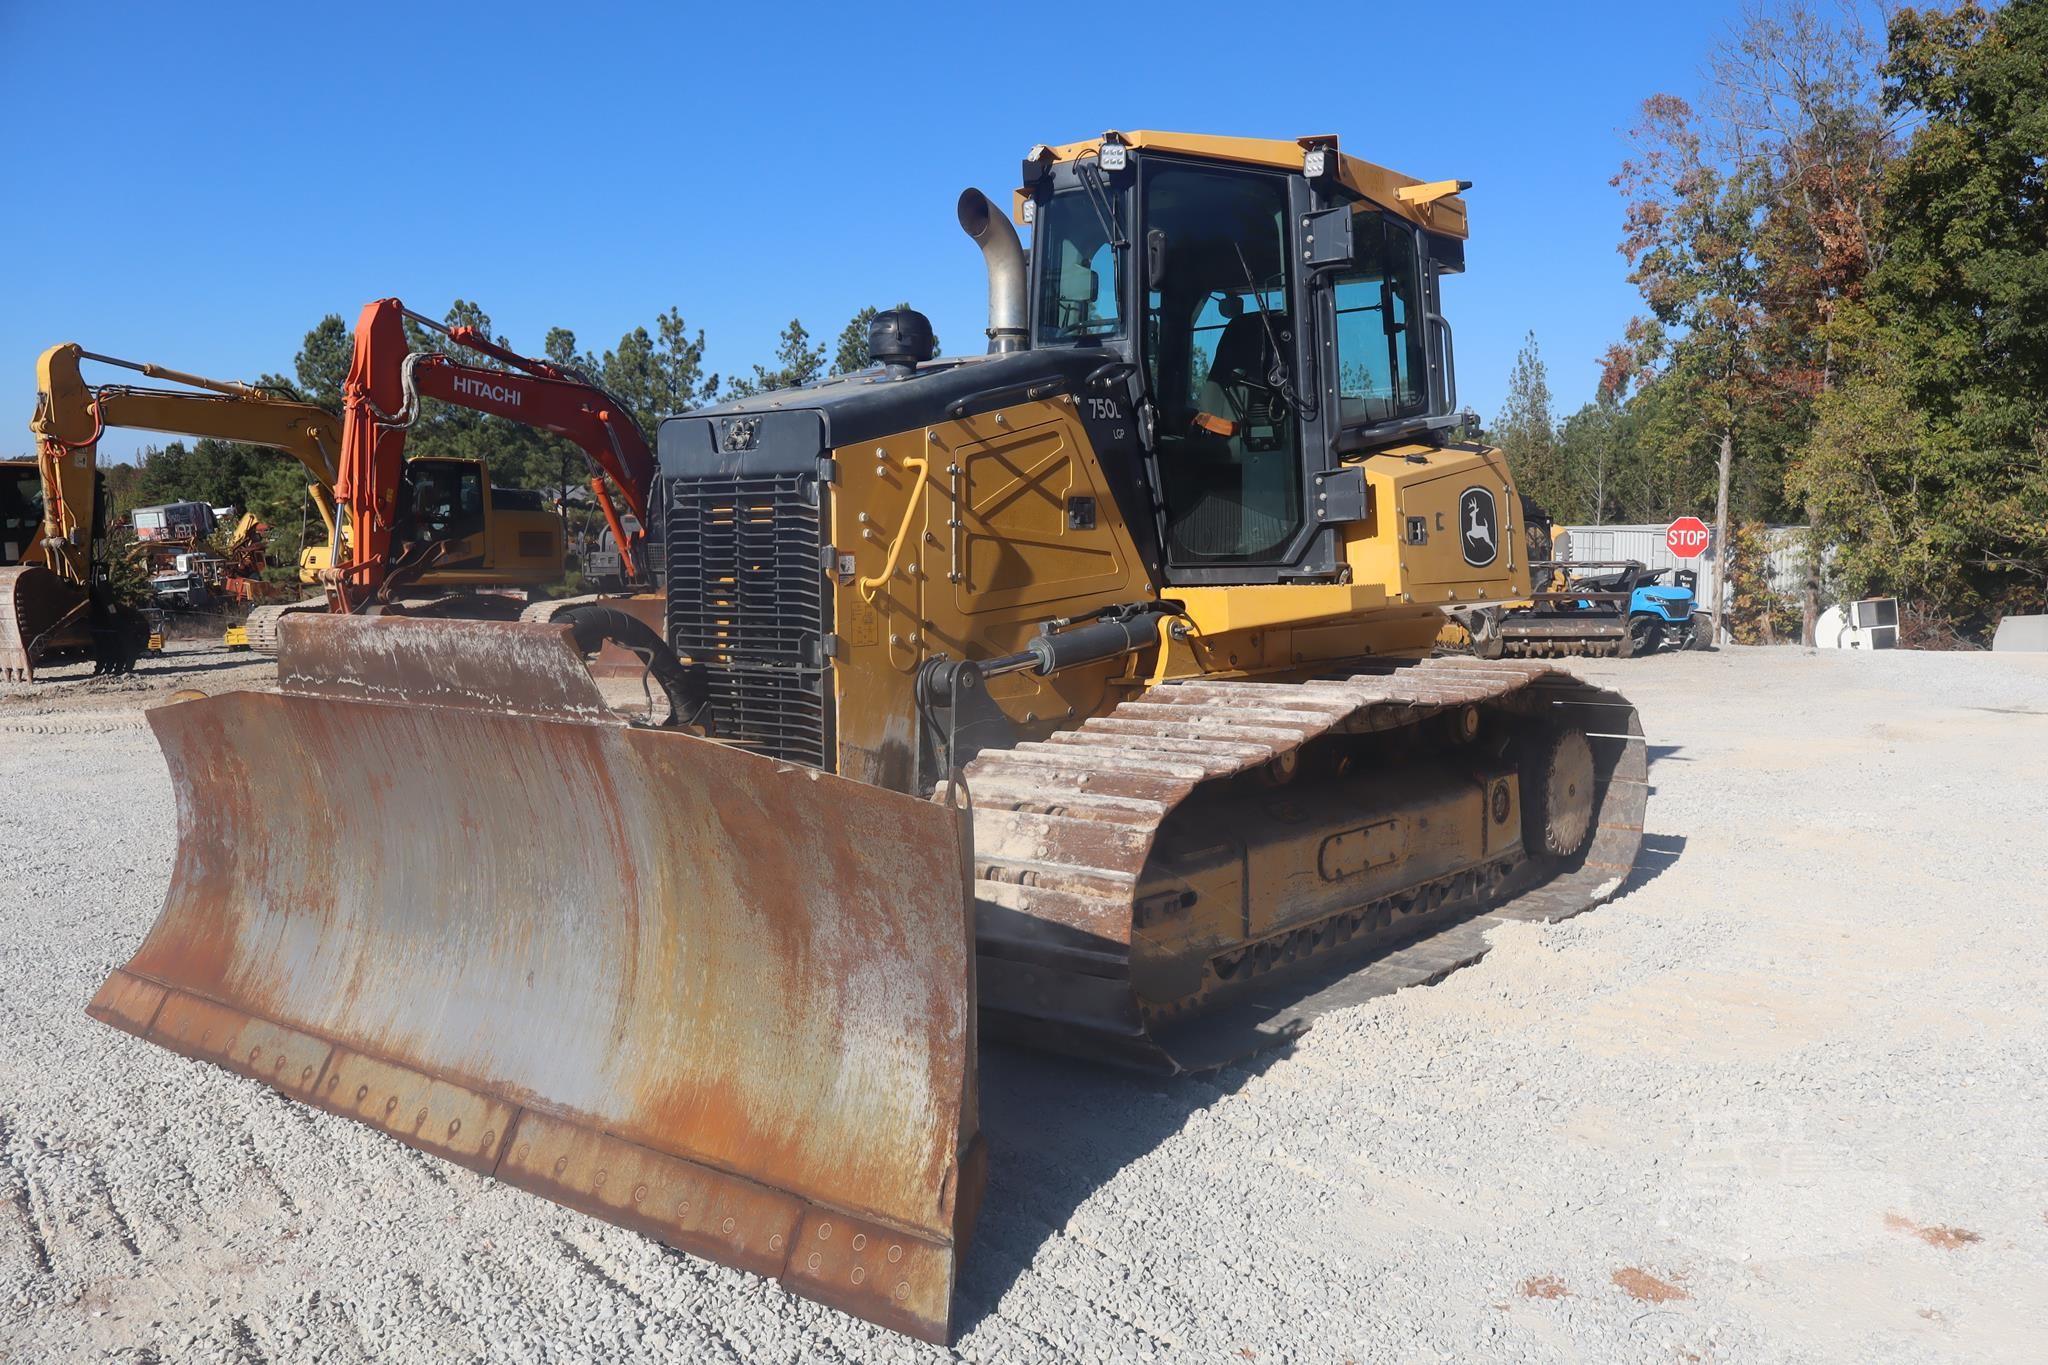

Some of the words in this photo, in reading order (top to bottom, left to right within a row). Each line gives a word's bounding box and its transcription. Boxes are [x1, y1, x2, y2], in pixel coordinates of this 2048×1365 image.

[453, 376, 521, 406] HITACHI
[1087, 398, 1122, 419] 750L
[1668, 530, 1707, 546] STOP
